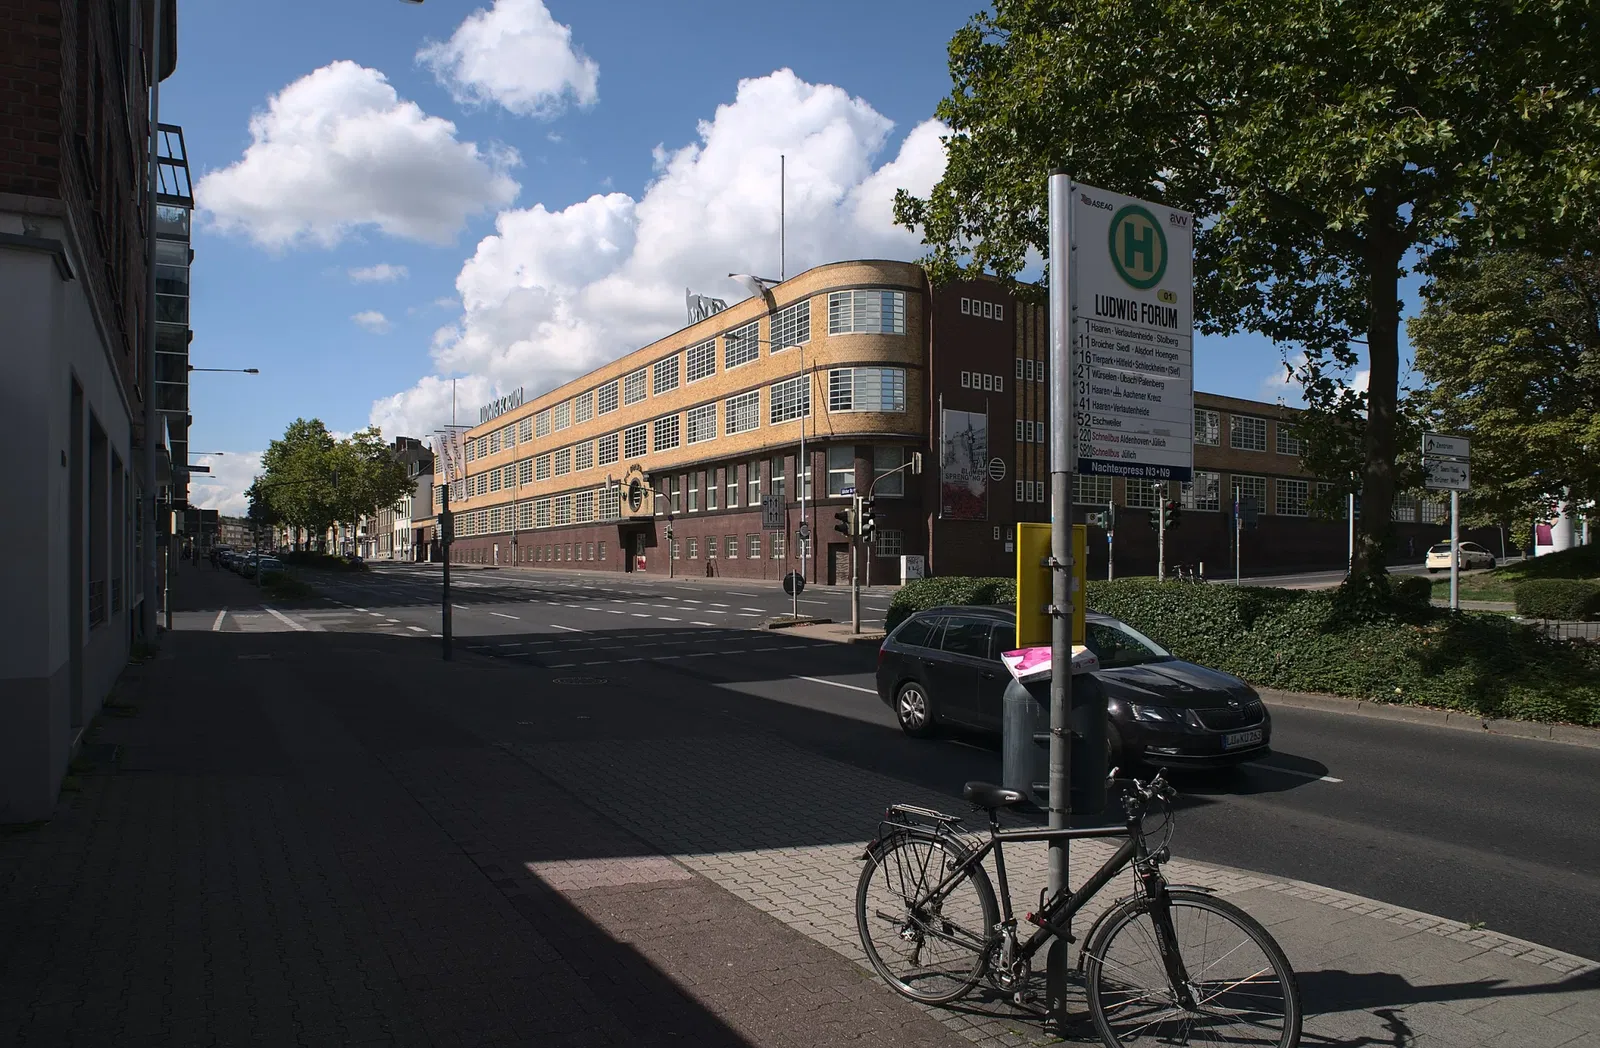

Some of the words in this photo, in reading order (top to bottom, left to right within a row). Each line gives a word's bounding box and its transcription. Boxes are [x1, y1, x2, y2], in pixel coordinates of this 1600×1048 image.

[1092, 200, 1113, 211] ASEAG
[1124, 222, 1153, 273] H
[1095, 294, 1137, 322] LUDWIG
[1141, 303, 1178, 329] FORUM
[1085, 320, 1090, 333] 1
[1091, 323, 1111, 334] Haaren
[1115, 326, 1153, 341] Verlautenheide
[1156, 334, 1178, 347] Stolberg
[1079, 334, 1090, 348] 11
[1091, 339, 1114, 350] Broicher
[1135, 345, 1154, 357] Alsdorf
[1156, 348, 1178, 361] Hoengen
[1080, 350, 1091, 364] 16
[1078, 364, 1090, 380] 21
[1092, 369, 1117, 381] Würselen
[1079, 381, 1090, 395] 31
[1091, 385, 1110, 396] Haaren
[1123, 389, 1146, 400] Aachener
[1079, 397, 1090, 410] 41
[1092, 401, 1110, 411] Haaren
[1077, 413, 1091, 427] 52
[1092, 416, 1121, 427] Eschweiler
[1079, 428, 1092, 442] 220
[1092, 431, 1119, 442] Schnellbus
[1120, 434, 1149, 445] Aldenhoven
[1151, 437, 1166, 447] Jülich
[1092, 447, 1119, 458] Schnellbus
[1120, 450, 1136, 459] Jülich
[1091, 462, 1144, 476] Nachtexpress
